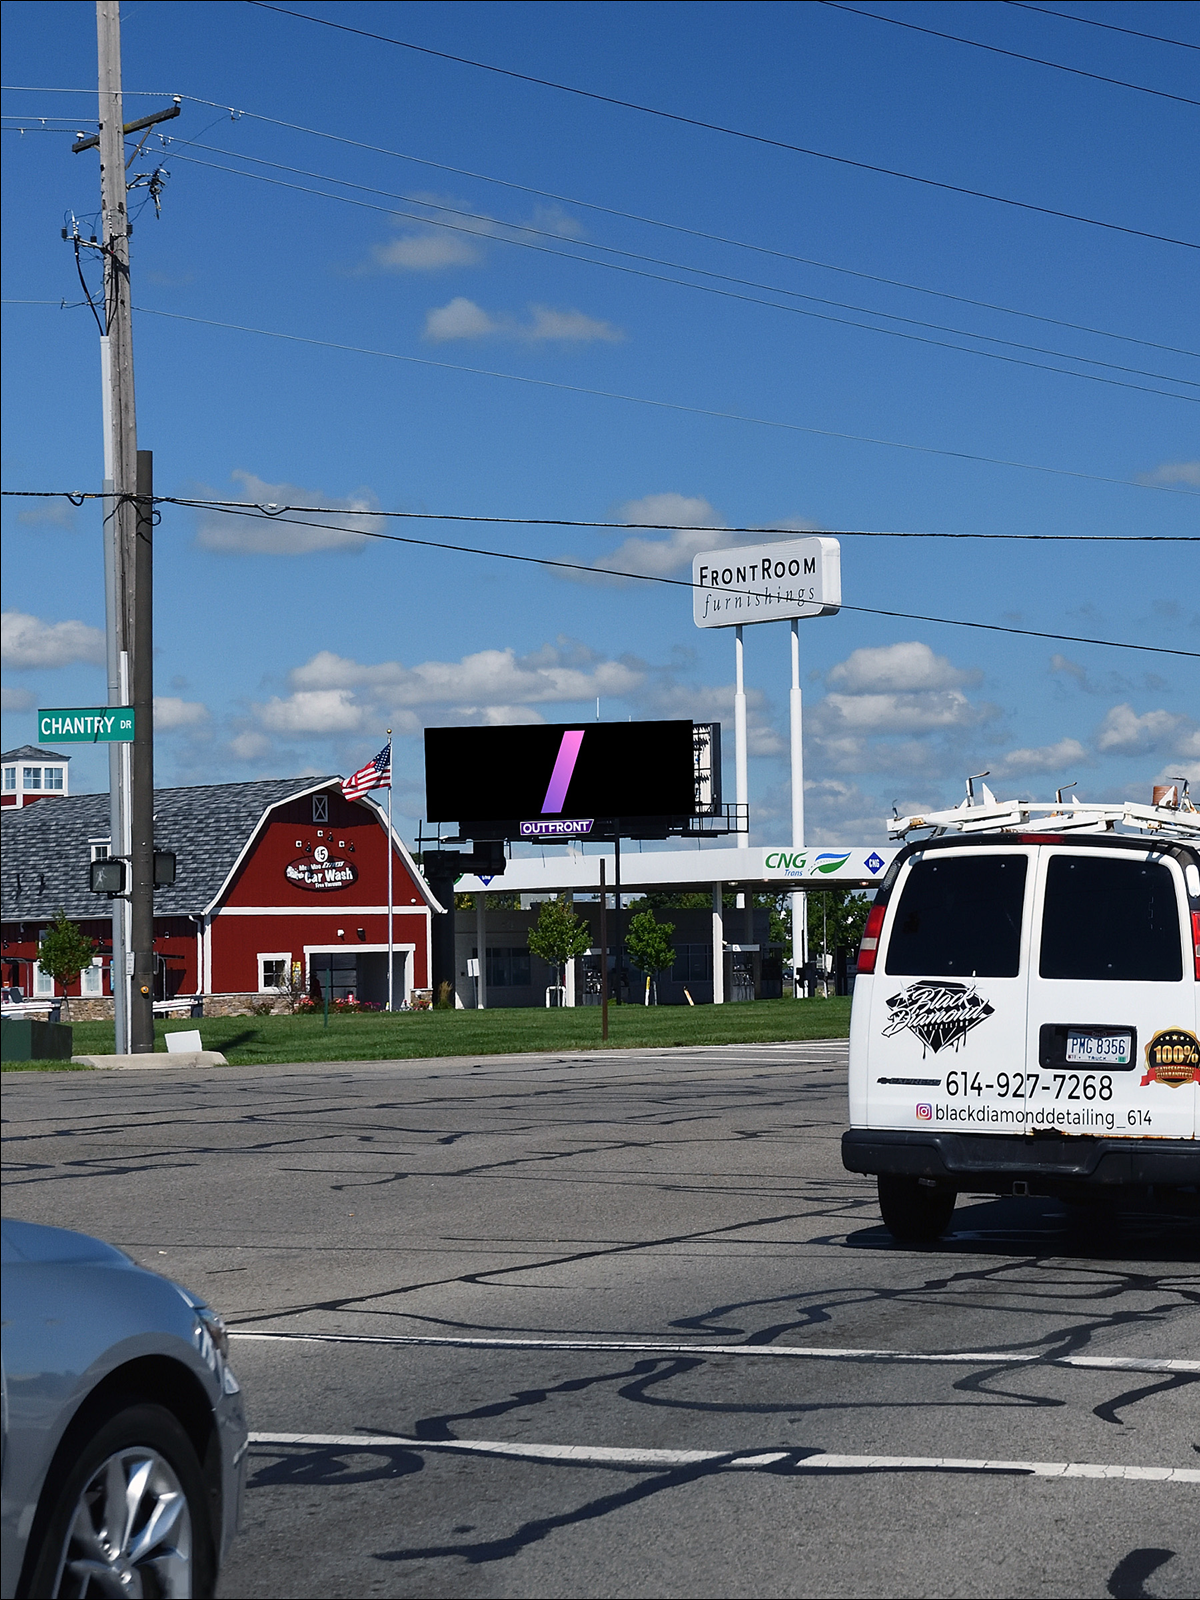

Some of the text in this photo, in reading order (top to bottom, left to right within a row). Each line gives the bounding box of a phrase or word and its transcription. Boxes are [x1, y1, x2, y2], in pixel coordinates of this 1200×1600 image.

[702, 586, 815, 618] furnishings
[41, 716, 132, 735] CHANTRY DR
[522, 821, 590, 833] OUTFRONT
[765, 850, 880, 869] CNG CNG
[304, 867, 354, 884] Car Wash
[784, 869, 803, 877] Trans
[912, 984, 976, 1013] Black
[881, 999, 990, 1038] Diamond
[1071, 1037, 1126, 1055] PMG 8356
[1153, 1044, 1199, 1063] 100%
[945, 1070, 1113, 1101] 614-927-7268
[935, 1104, 1152, 1129] blackdiamonddetailing_614
